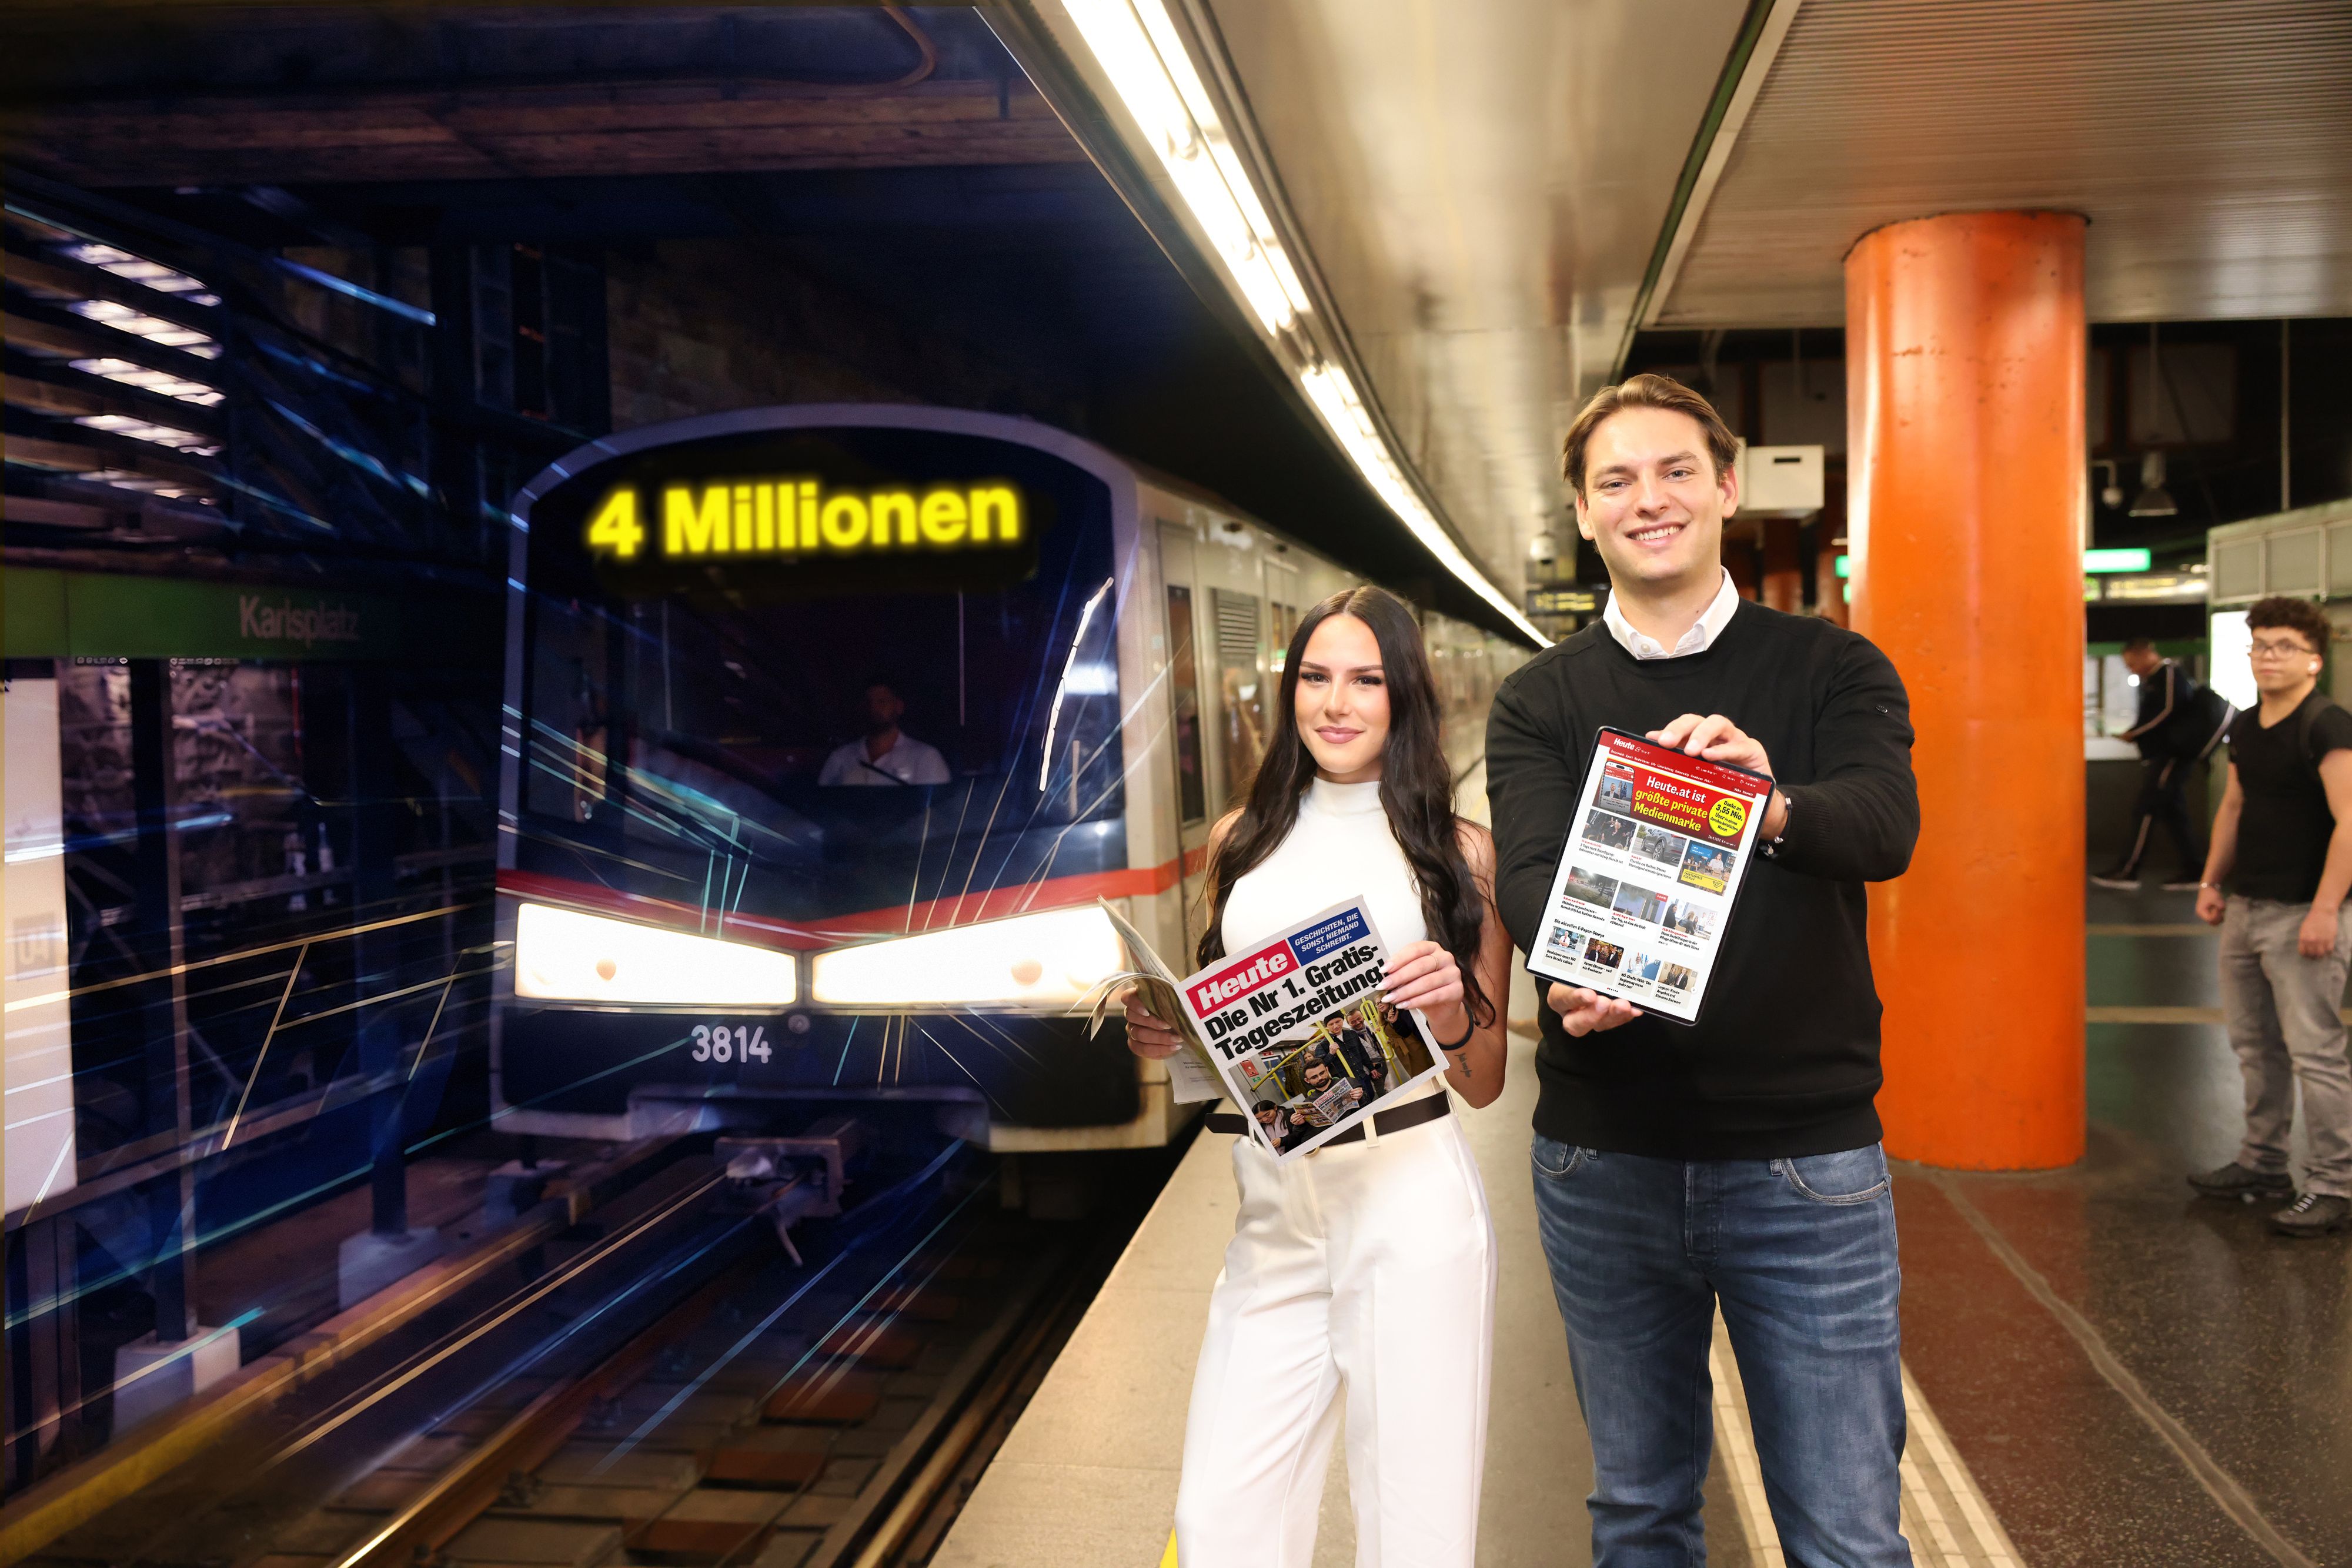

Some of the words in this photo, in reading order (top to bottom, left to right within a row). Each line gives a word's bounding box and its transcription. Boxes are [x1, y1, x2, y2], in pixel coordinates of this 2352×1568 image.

[590, 490, 643, 556] 4
[666, 482, 1018, 554] Millionen
[239, 595, 359, 649] Karlsplatz
[1613, 737, 1635, 750] Heute
[1634, 786, 1671, 809] größte
[1670, 798, 1709, 821] private
[1646, 775, 1692, 798] Heute.at
[1691, 790, 1707, 803] ist
[1633, 801, 1703, 831] Medienmarke
[1716, 804, 1730, 814] 3,55
[1730, 810, 1743, 821] Mio.
[1294, 919, 1345, 946] GESCHICHTEN,
[1347, 912, 1359, 922] DIE
[1301, 936, 1325, 952] SONST
[1326, 921, 1359, 939] NIEMAND
[1561, 921, 1577, 929] aktuellen
[1316, 933, 1352, 954] SCHREIBT.
[1197, 952, 1288, 1011] Heute
[1204, 1009, 1248, 1041] Die
[1248, 989, 1279, 1017] Nr
[1282, 978, 1306, 998] 1.
[1305, 945, 1379, 988] Gratis-
[1214, 958, 1388, 1061] Tageszeitung!
[691, 1025, 773, 1064] 3814
